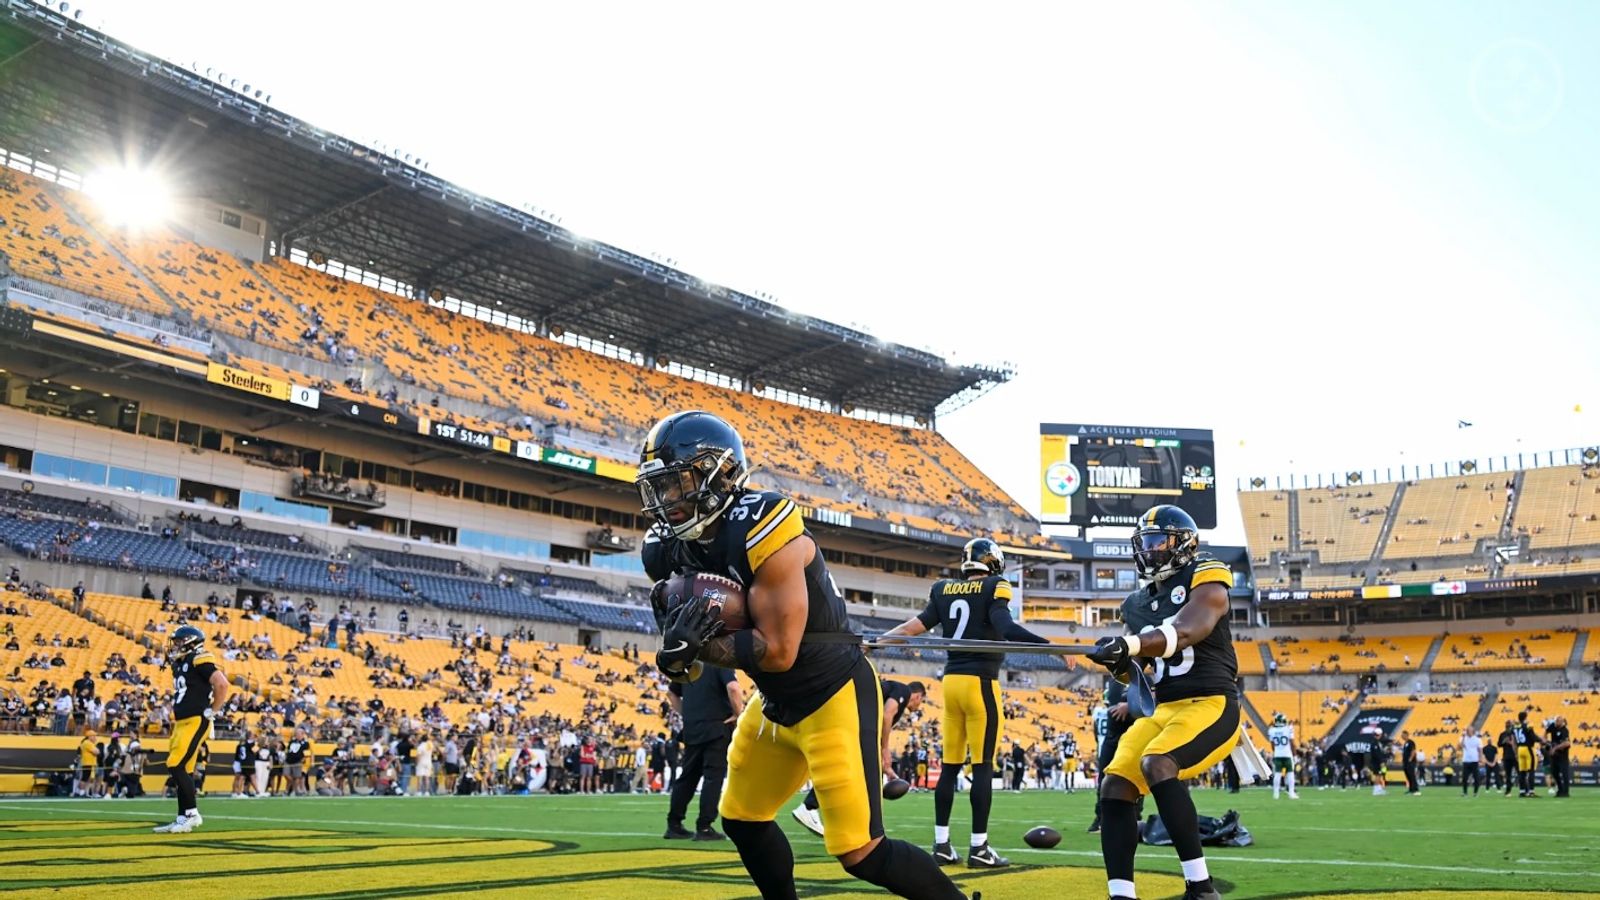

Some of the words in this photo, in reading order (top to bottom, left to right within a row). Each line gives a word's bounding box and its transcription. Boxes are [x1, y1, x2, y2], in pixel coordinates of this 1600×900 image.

[221, 368, 273, 394] Steelers
[300, 390, 309, 402] 0
[351, 405, 359, 415] &
[383, 413, 398, 425] ON
[436, 423, 456, 438] 1ST
[460, 431, 490, 447] 51:44
[525, 446, 532, 456] 0
[548, 452, 592, 470] JETS
[1090, 427, 1136, 436] ACRISURE
[1139, 428, 1177, 437] STADIUM
[1087, 465, 1141, 488] TONYAN
[728, 493, 763, 521] 30
[1100, 515, 1138, 524] ACRISURE
[1096, 545, 1120, 555] BUD
[943, 580, 983, 595] RUDOLPH
[949, 599, 970, 640] 2
[1513, 728, 1526, 744] 16
[1345, 742, 1372, 753] HEINZ
